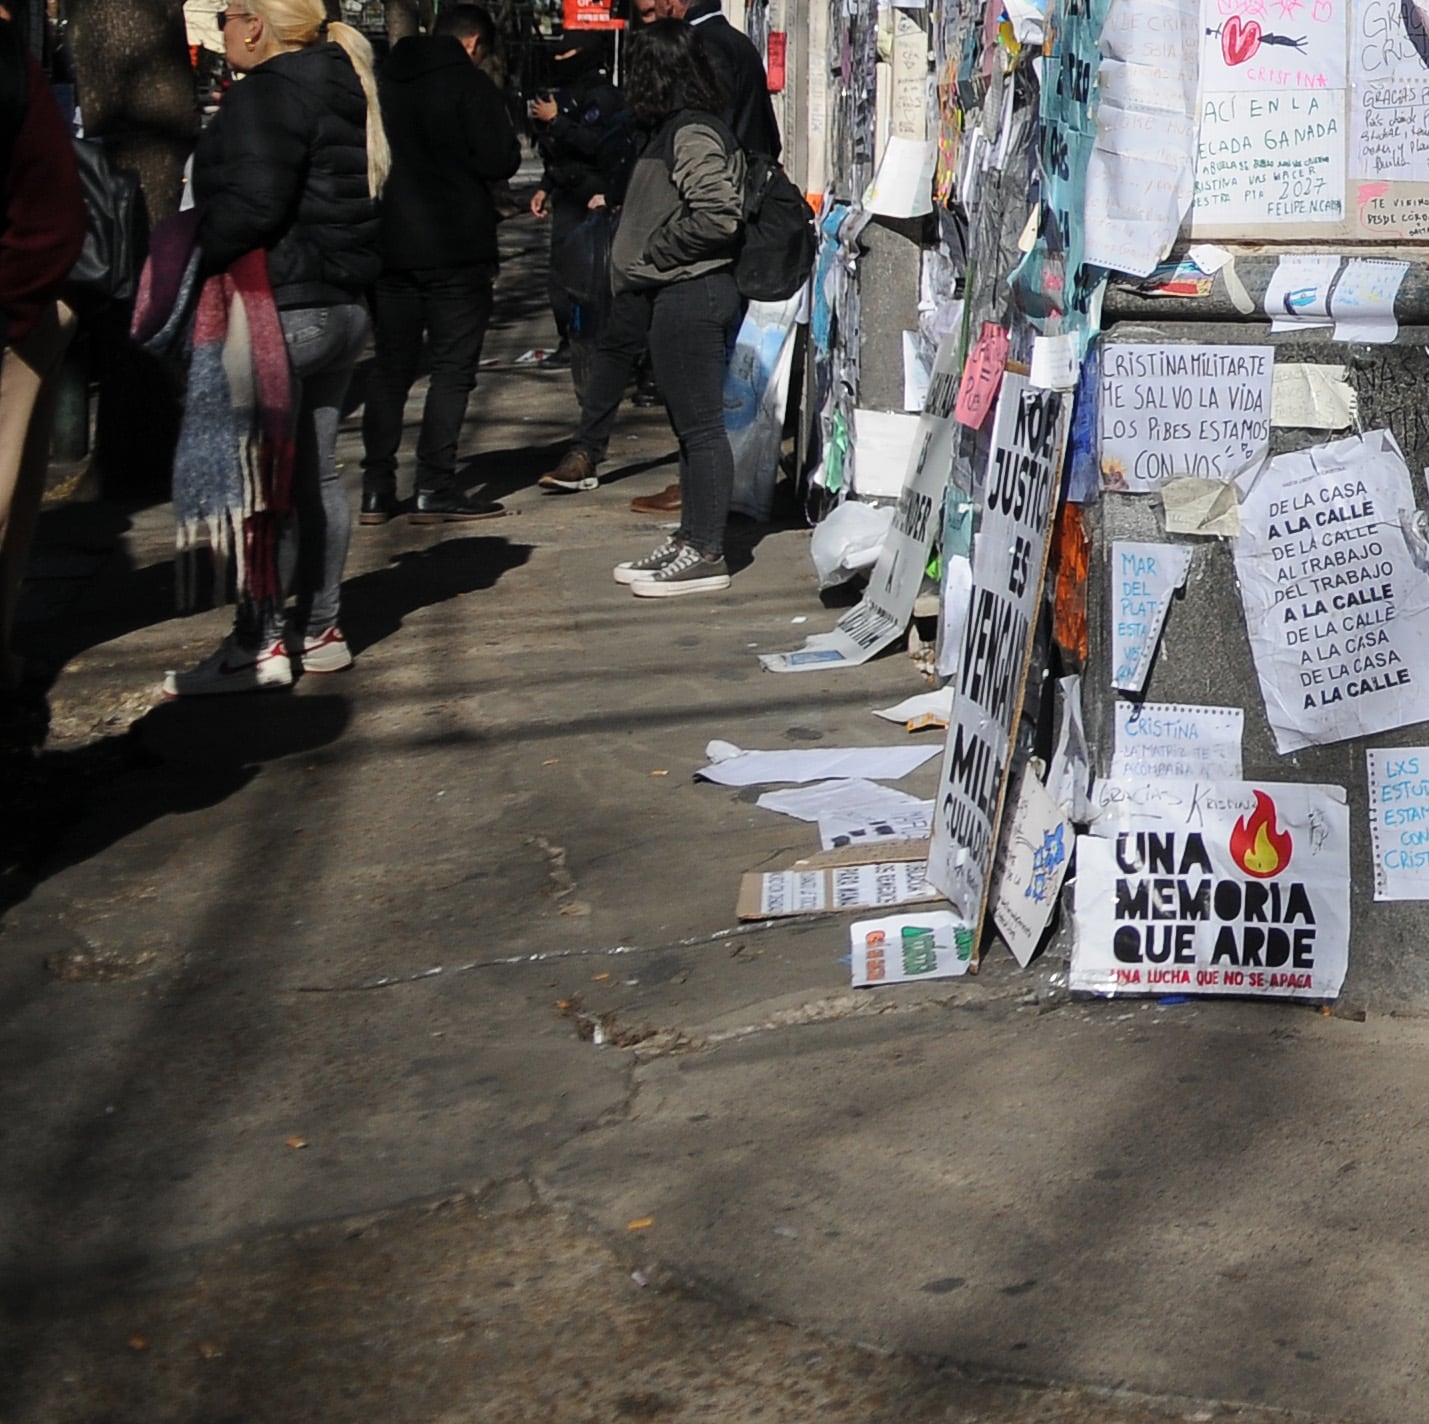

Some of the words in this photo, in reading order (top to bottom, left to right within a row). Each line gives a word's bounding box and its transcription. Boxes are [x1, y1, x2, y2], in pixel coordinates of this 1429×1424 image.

[1267, 522, 1282, 540] A
[1285, 517, 1311, 537] LA
[1314, 500, 1375, 529] CALLE
[1269, 501, 1291, 518] DE
[1293, 497, 1317, 515] LA
[1322, 481, 1368, 509] CASA
[1116, 831, 1214, 875] UNA
[1113, 878, 1316, 925] MEMORIA
[1112, 925, 1197, 965] QUE
[1211, 925, 1315, 969] ARDE
[1110, 968, 1142, 985] UNA
[1146, 969, 1191, 985] LUCHA
[1196, 969, 1219, 987] QUE
[1223, 971, 1243, 987] NO
[1249, 972, 1264, 988] SE
[1269, 973, 1312, 990] APAGA
